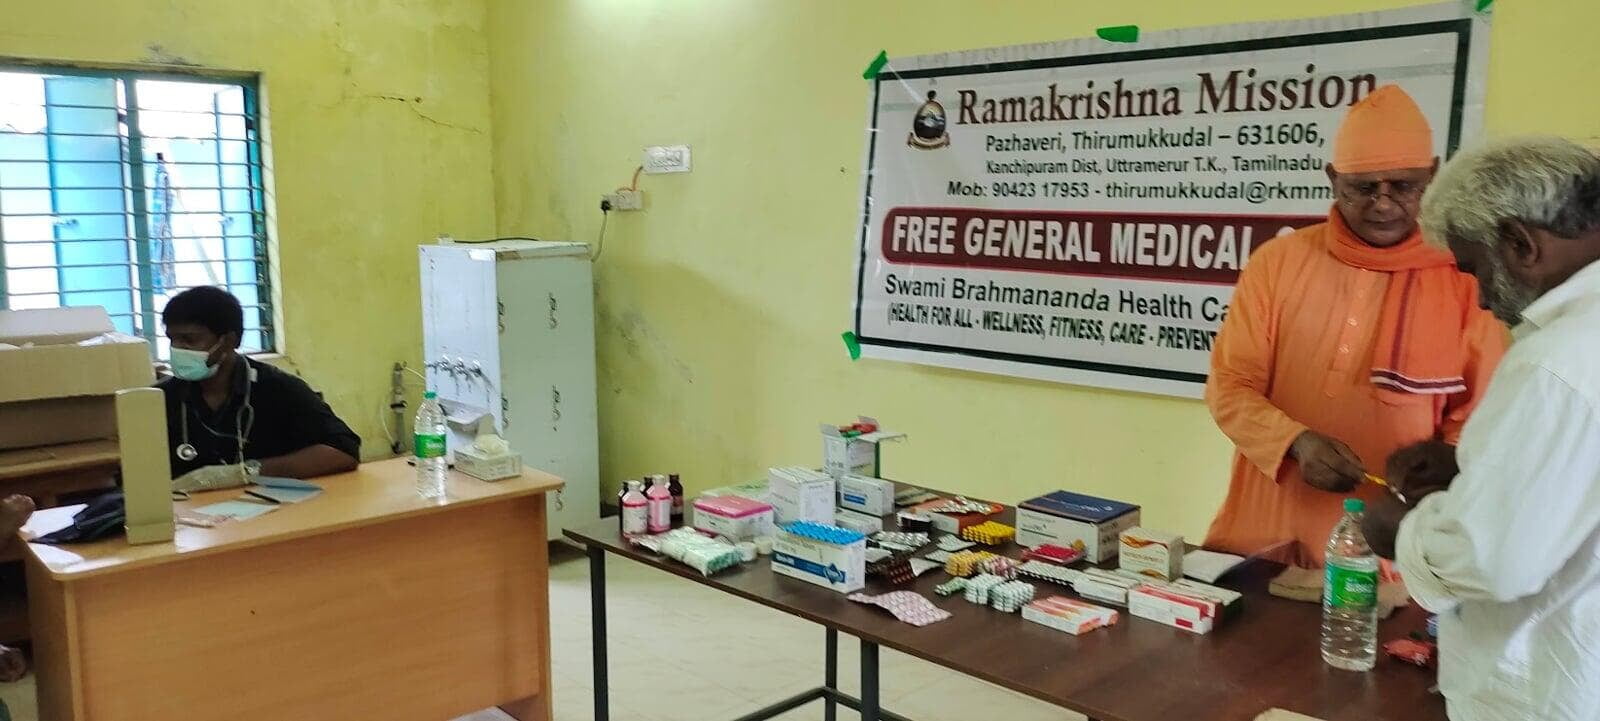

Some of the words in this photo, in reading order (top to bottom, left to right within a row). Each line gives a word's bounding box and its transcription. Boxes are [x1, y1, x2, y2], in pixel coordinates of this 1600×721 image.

[955, 79, 1182, 125] Ramakrishna
[1194, 63, 1377, 115] Mission
[986, 131, 1067, 153] Pazhaveri,
[1072, 125, 1213, 150] Thirumukkudal
[1236, 122, 1325, 148] 631606,
[986, 159, 1068, 177] Kanchipuram
[1072, 158, 1103, 175] Dist,
[1105, 157, 1190, 173] Uttramerur
[1232, 153, 1323, 172] Tamilnadu
[947, 181, 988, 198] Mob:
[992, 182, 1036, 198] 90423
[1043, 182, 1089, 198] 17953
[892, 215, 958, 255] FREE
[963, 217, 1101, 263] GENERAL
[1109, 222, 1253, 271] MEDICAL
[885, 273, 946, 298] Swami
[952, 277, 1110, 312] Brahmananda
[1118, 289, 1193, 320] Health
[931, 305, 951, 327] FOR
[954, 307, 973, 329] ALL
[983, 309, 1046, 340] WELLNESS,
[1050, 315, 1105, 346] FITNESS,
[1110, 321, 1148, 346] CARE
